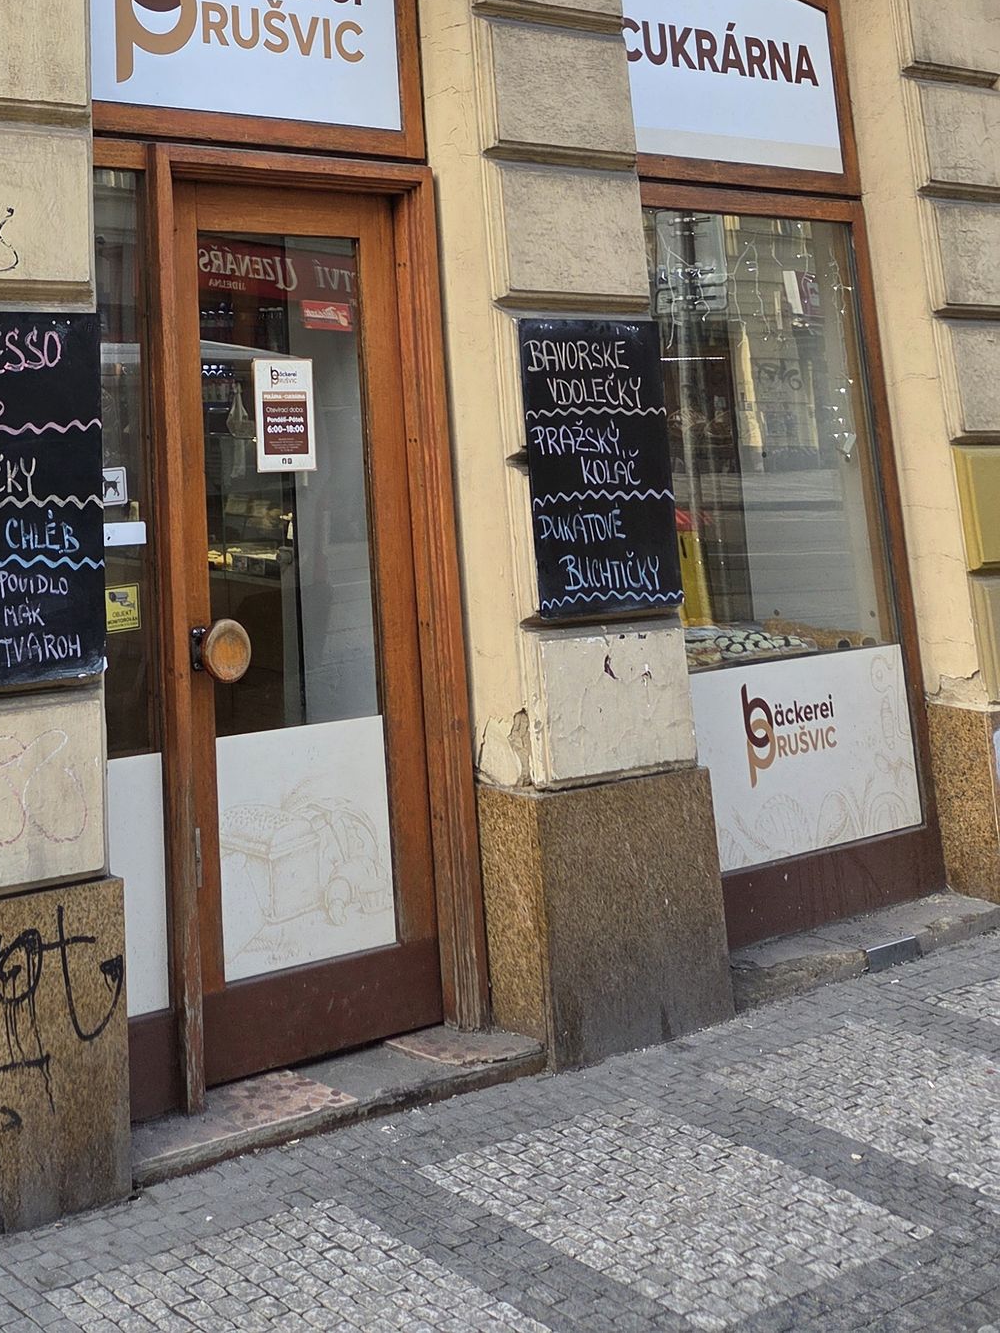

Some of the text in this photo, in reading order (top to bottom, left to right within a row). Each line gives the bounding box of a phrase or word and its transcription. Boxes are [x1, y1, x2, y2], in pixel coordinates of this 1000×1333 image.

[622, 17, 820, 87] CUKRÁRNA
[523, 327, 630, 372] BAVORSKÉ
[546, 372, 642, 408] VDOLEČKY
[530, 418, 620, 456] PRAŽSKÝ
[580, 448, 641, 486] KOLÁČ
[5, 508, 81, 555] CHLÉB
[538, 501, 627, 545] DUKÁTOVÉ
[558, 550, 660, 591] BUCHTIČKY
[741, 683, 834, 748] bäckerei
